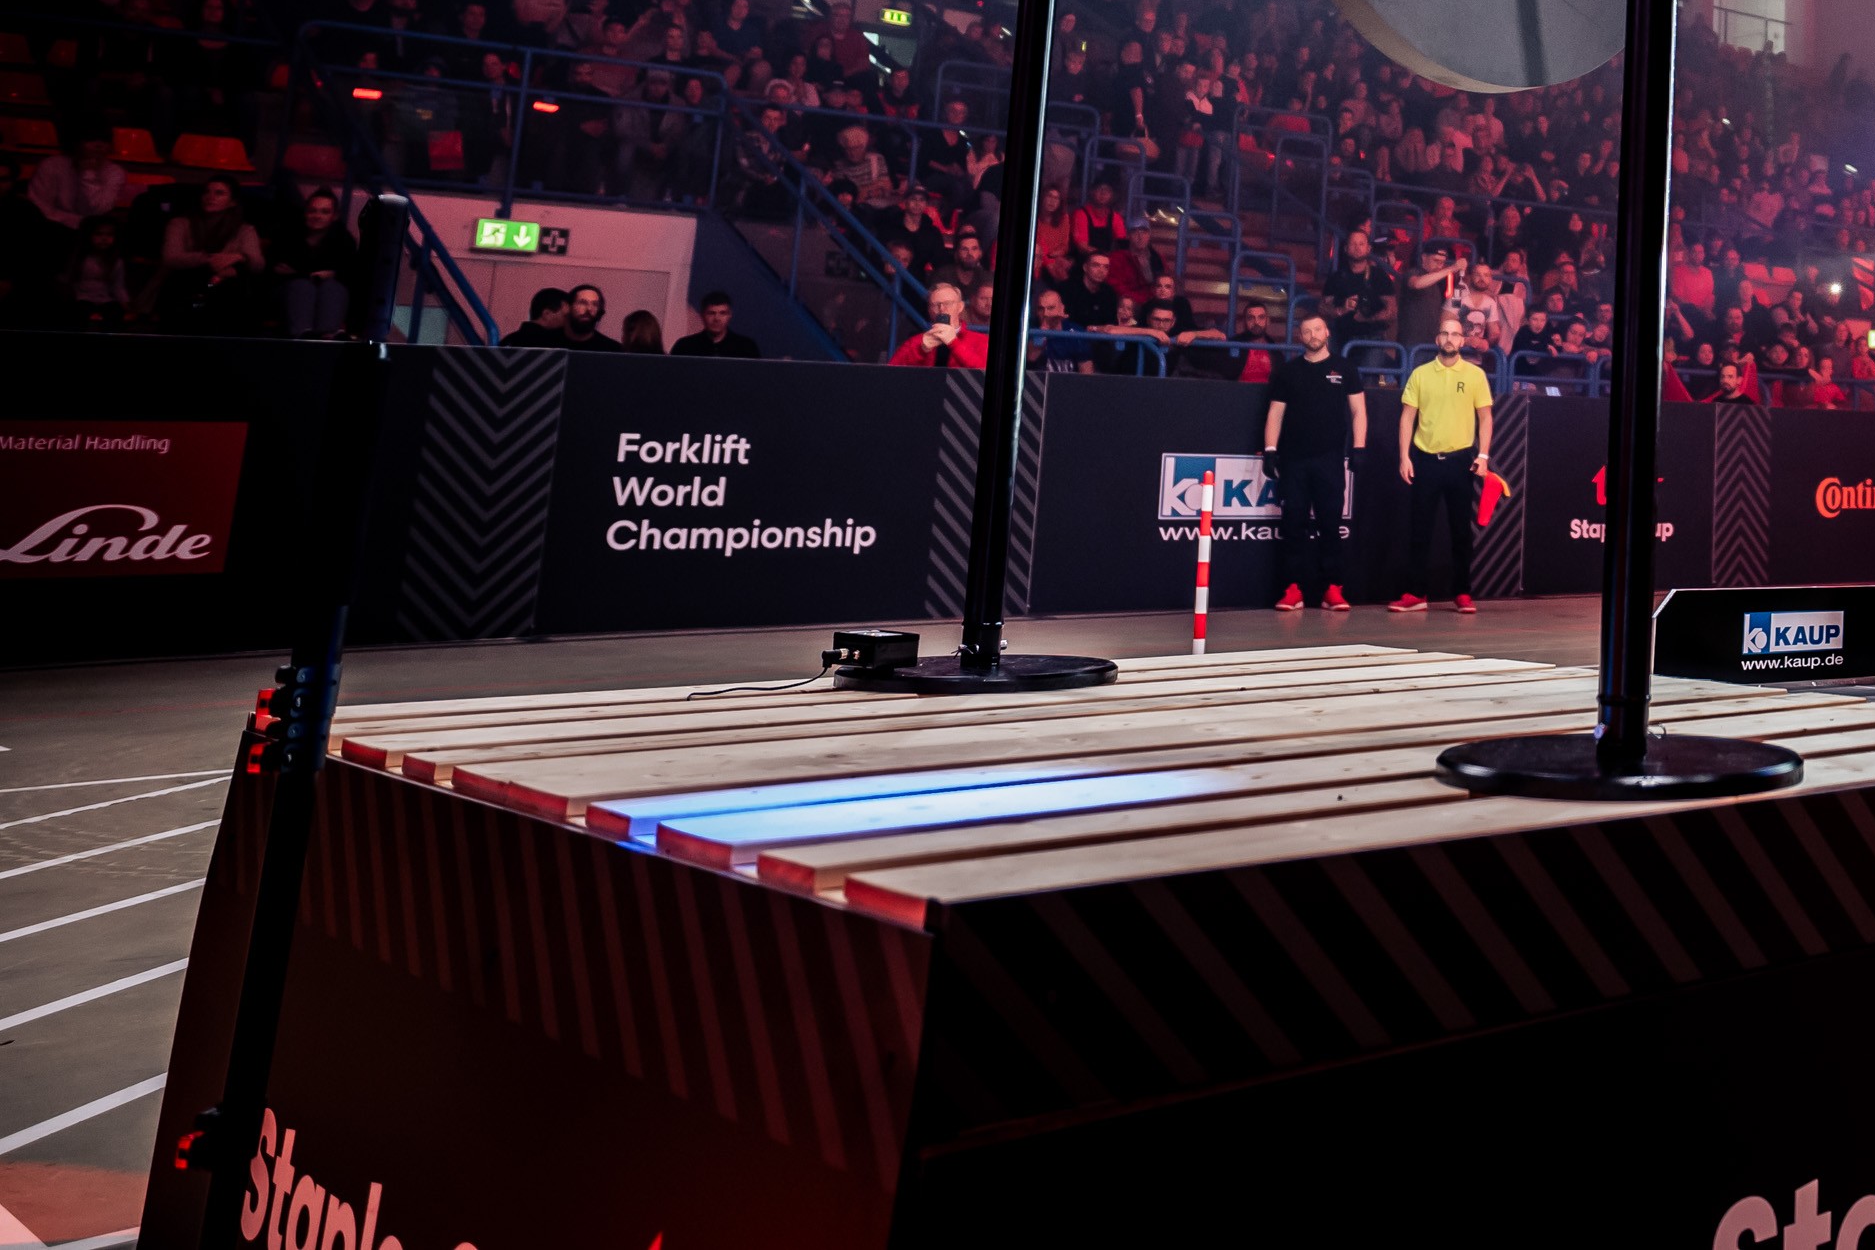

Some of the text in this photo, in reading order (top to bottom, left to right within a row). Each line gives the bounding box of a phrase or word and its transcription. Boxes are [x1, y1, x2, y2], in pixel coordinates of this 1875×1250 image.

[1456, 381, 1465, 393] R
[0, 434, 171, 454] Material Handling
[617, 432, 751, 465] Forklift
[612, 476, 727, 507] World
[0, 503, 213, 564] Linde
[605, 517, 878, 558] Championship
[1774, 624, 1841, 647] KAUP
[1741, 653, 1844, 670] www.kaup.de
